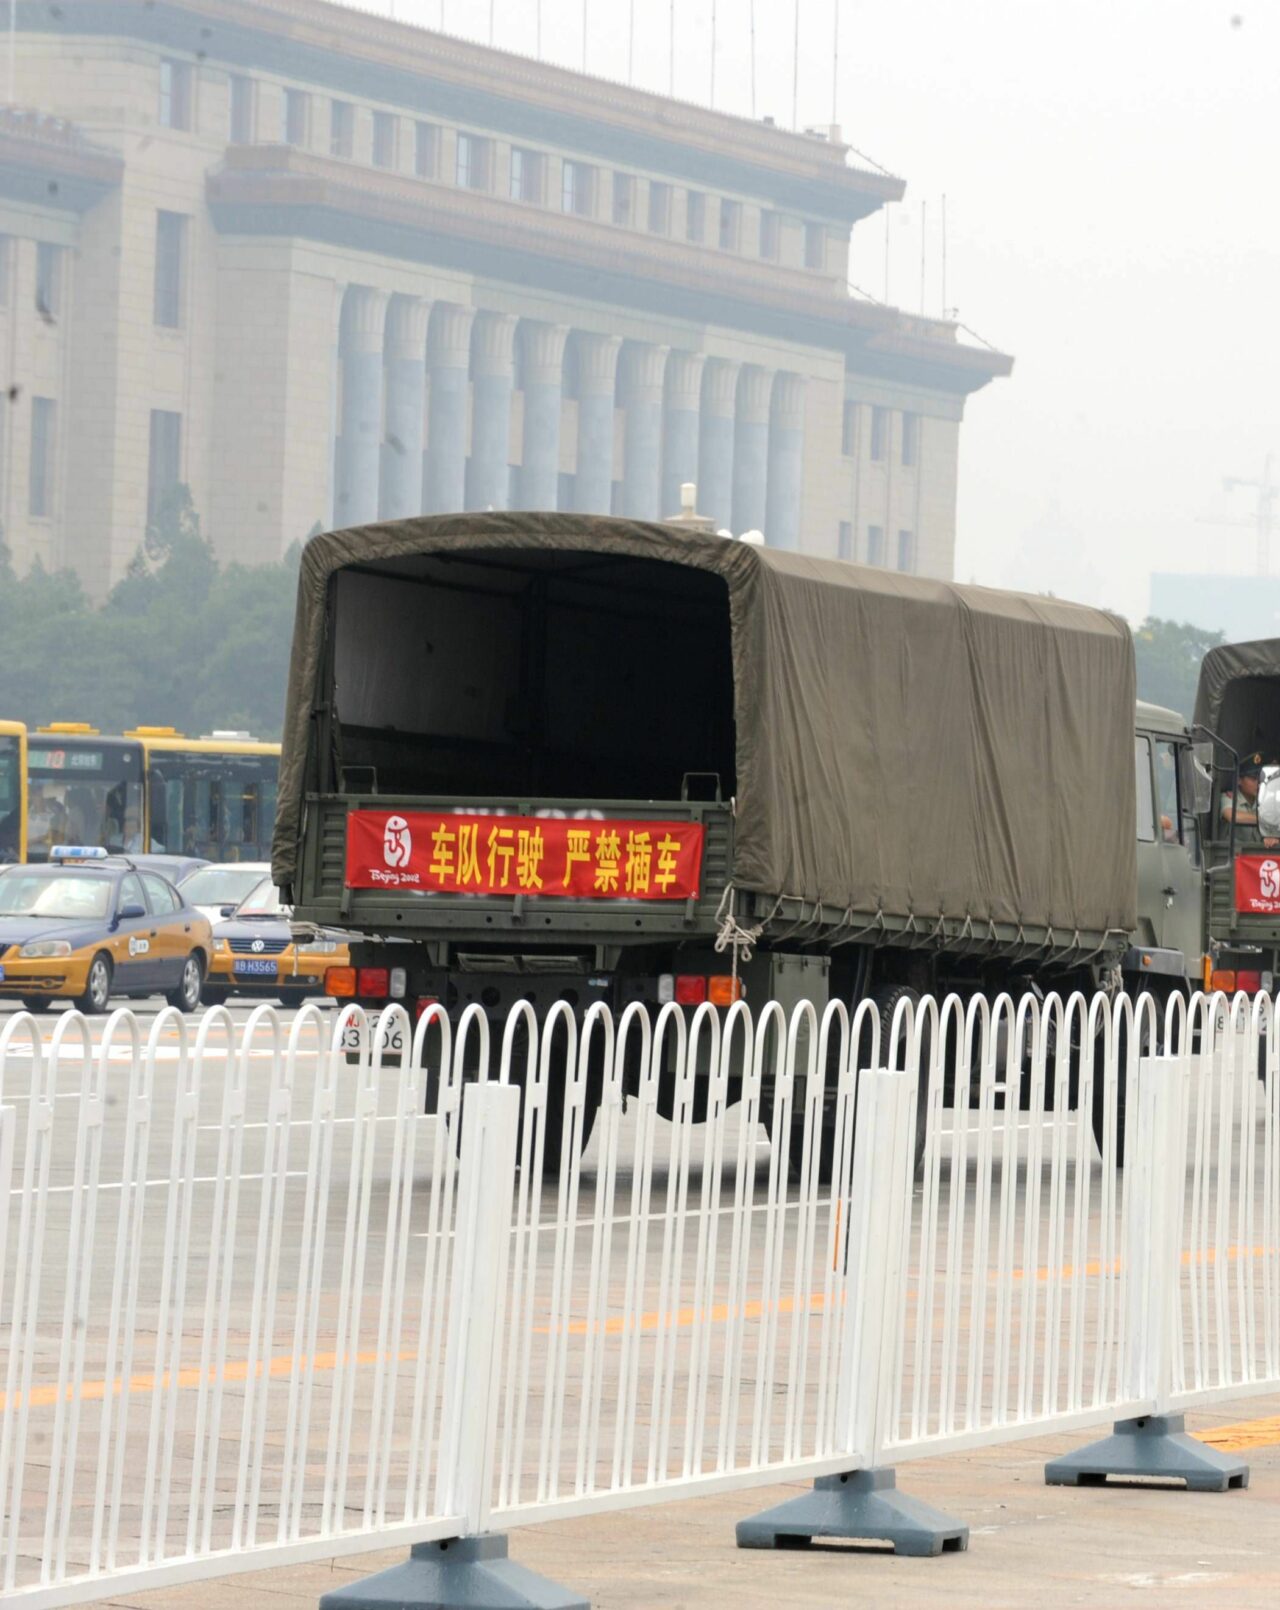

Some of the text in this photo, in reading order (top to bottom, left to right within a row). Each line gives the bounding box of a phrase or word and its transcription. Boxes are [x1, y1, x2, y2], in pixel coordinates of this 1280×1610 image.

[429, 822, 682, 894] 车队行驶 严禁插车
